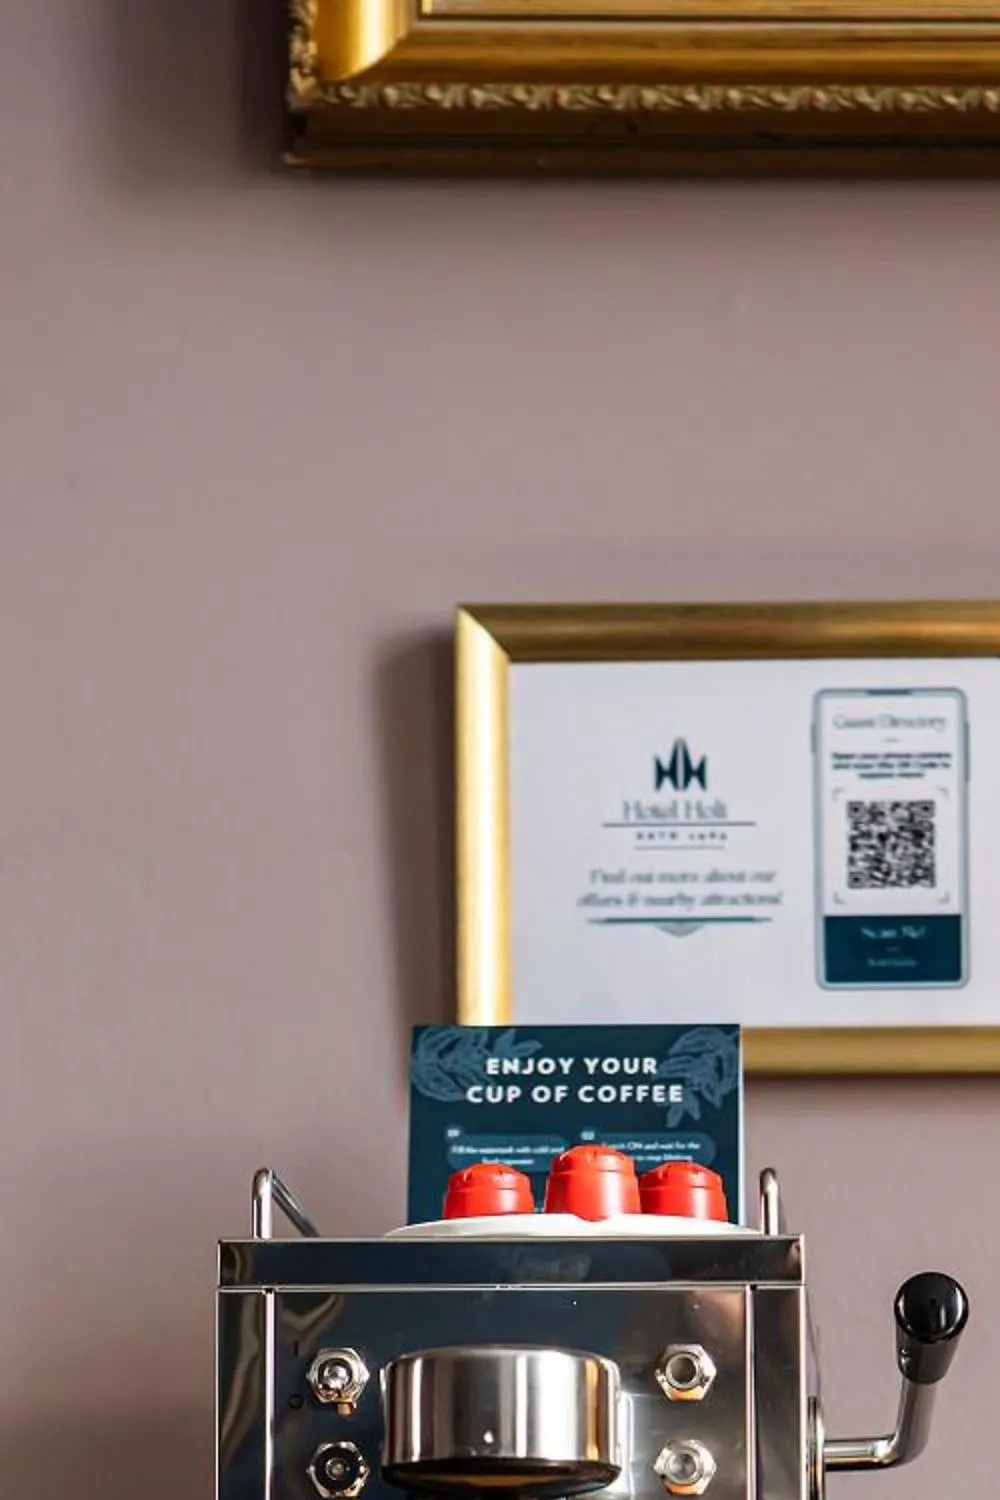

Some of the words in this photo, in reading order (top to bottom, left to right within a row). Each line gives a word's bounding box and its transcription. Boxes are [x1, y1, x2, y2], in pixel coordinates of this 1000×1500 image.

[485, 1057, 574, 1075] ENJOY
[584, 1056, 658, 1075] YOUR
[466, 1085, 521, 1103] CUP
[531, 1085, 570, 1103] OF
[577, 1084, 683, 1103] COFFEE
